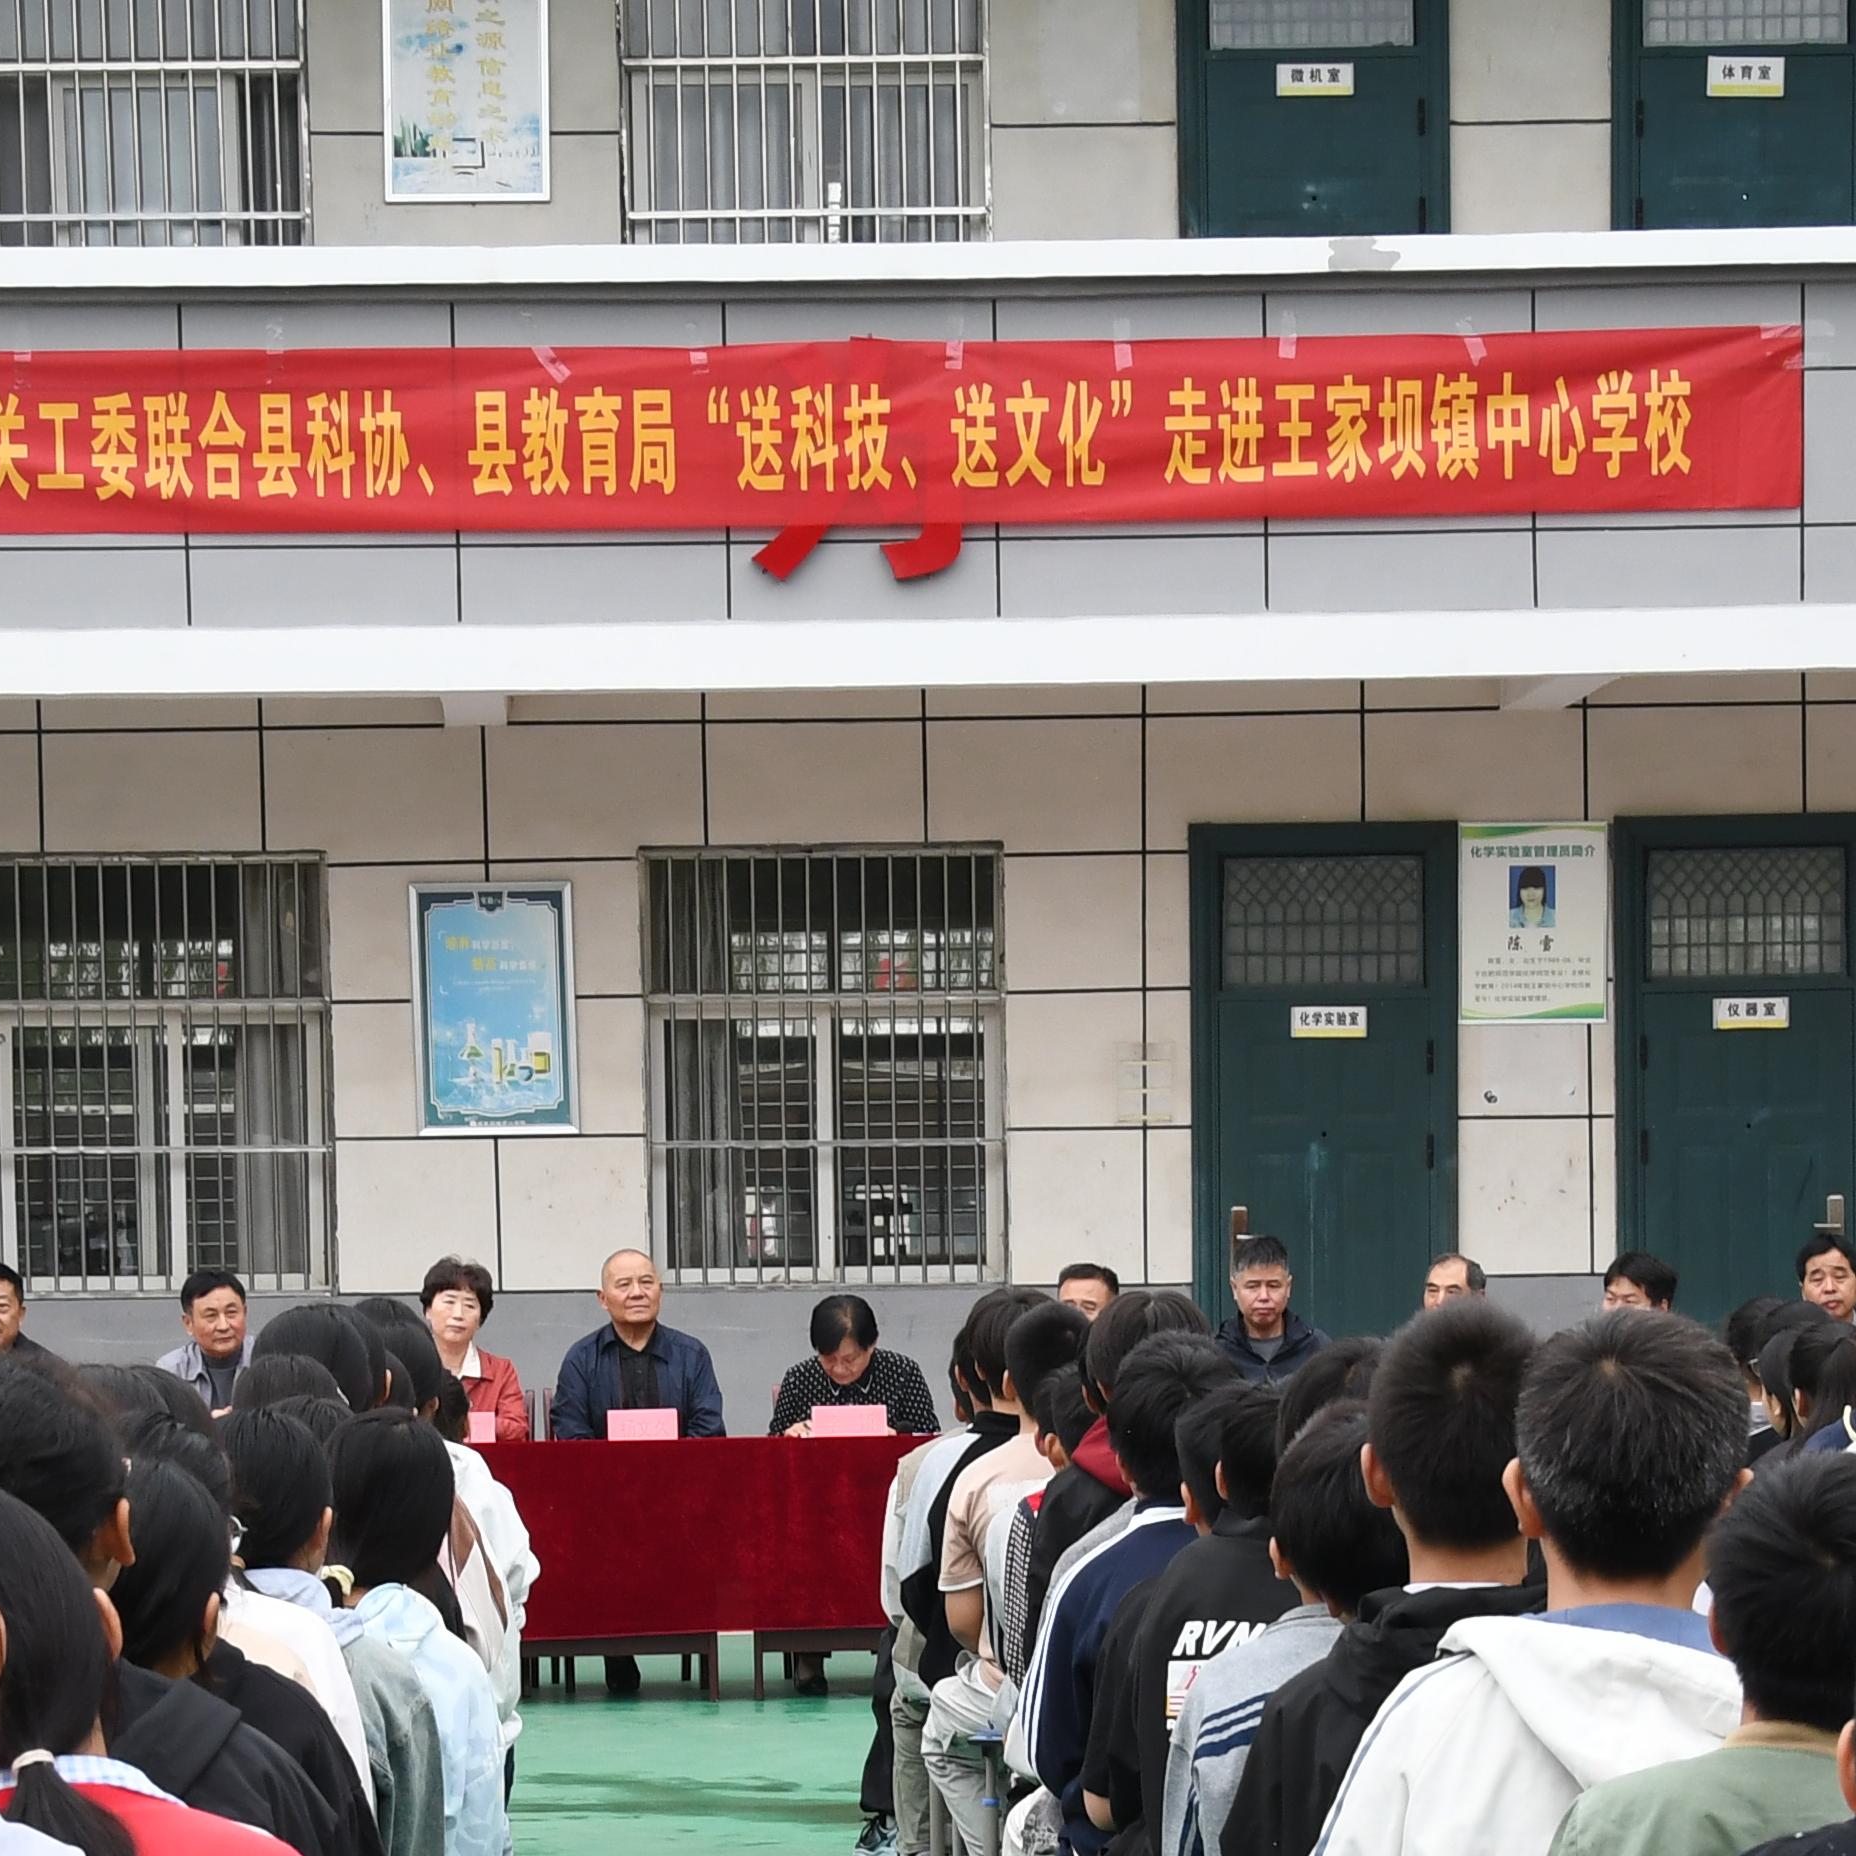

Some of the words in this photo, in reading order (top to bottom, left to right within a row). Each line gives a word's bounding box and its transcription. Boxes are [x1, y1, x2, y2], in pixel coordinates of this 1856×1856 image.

[1289, 66, 1342, 84] 微机室
[1721, 63, 1772, 81] 体育室
[1470, 844, 1596, 859] 化学实验室管理员简介
[1727, 1002, 1777, 1018] 仪器室
[1299, 1011, 1359, 1027] 化学实验室
